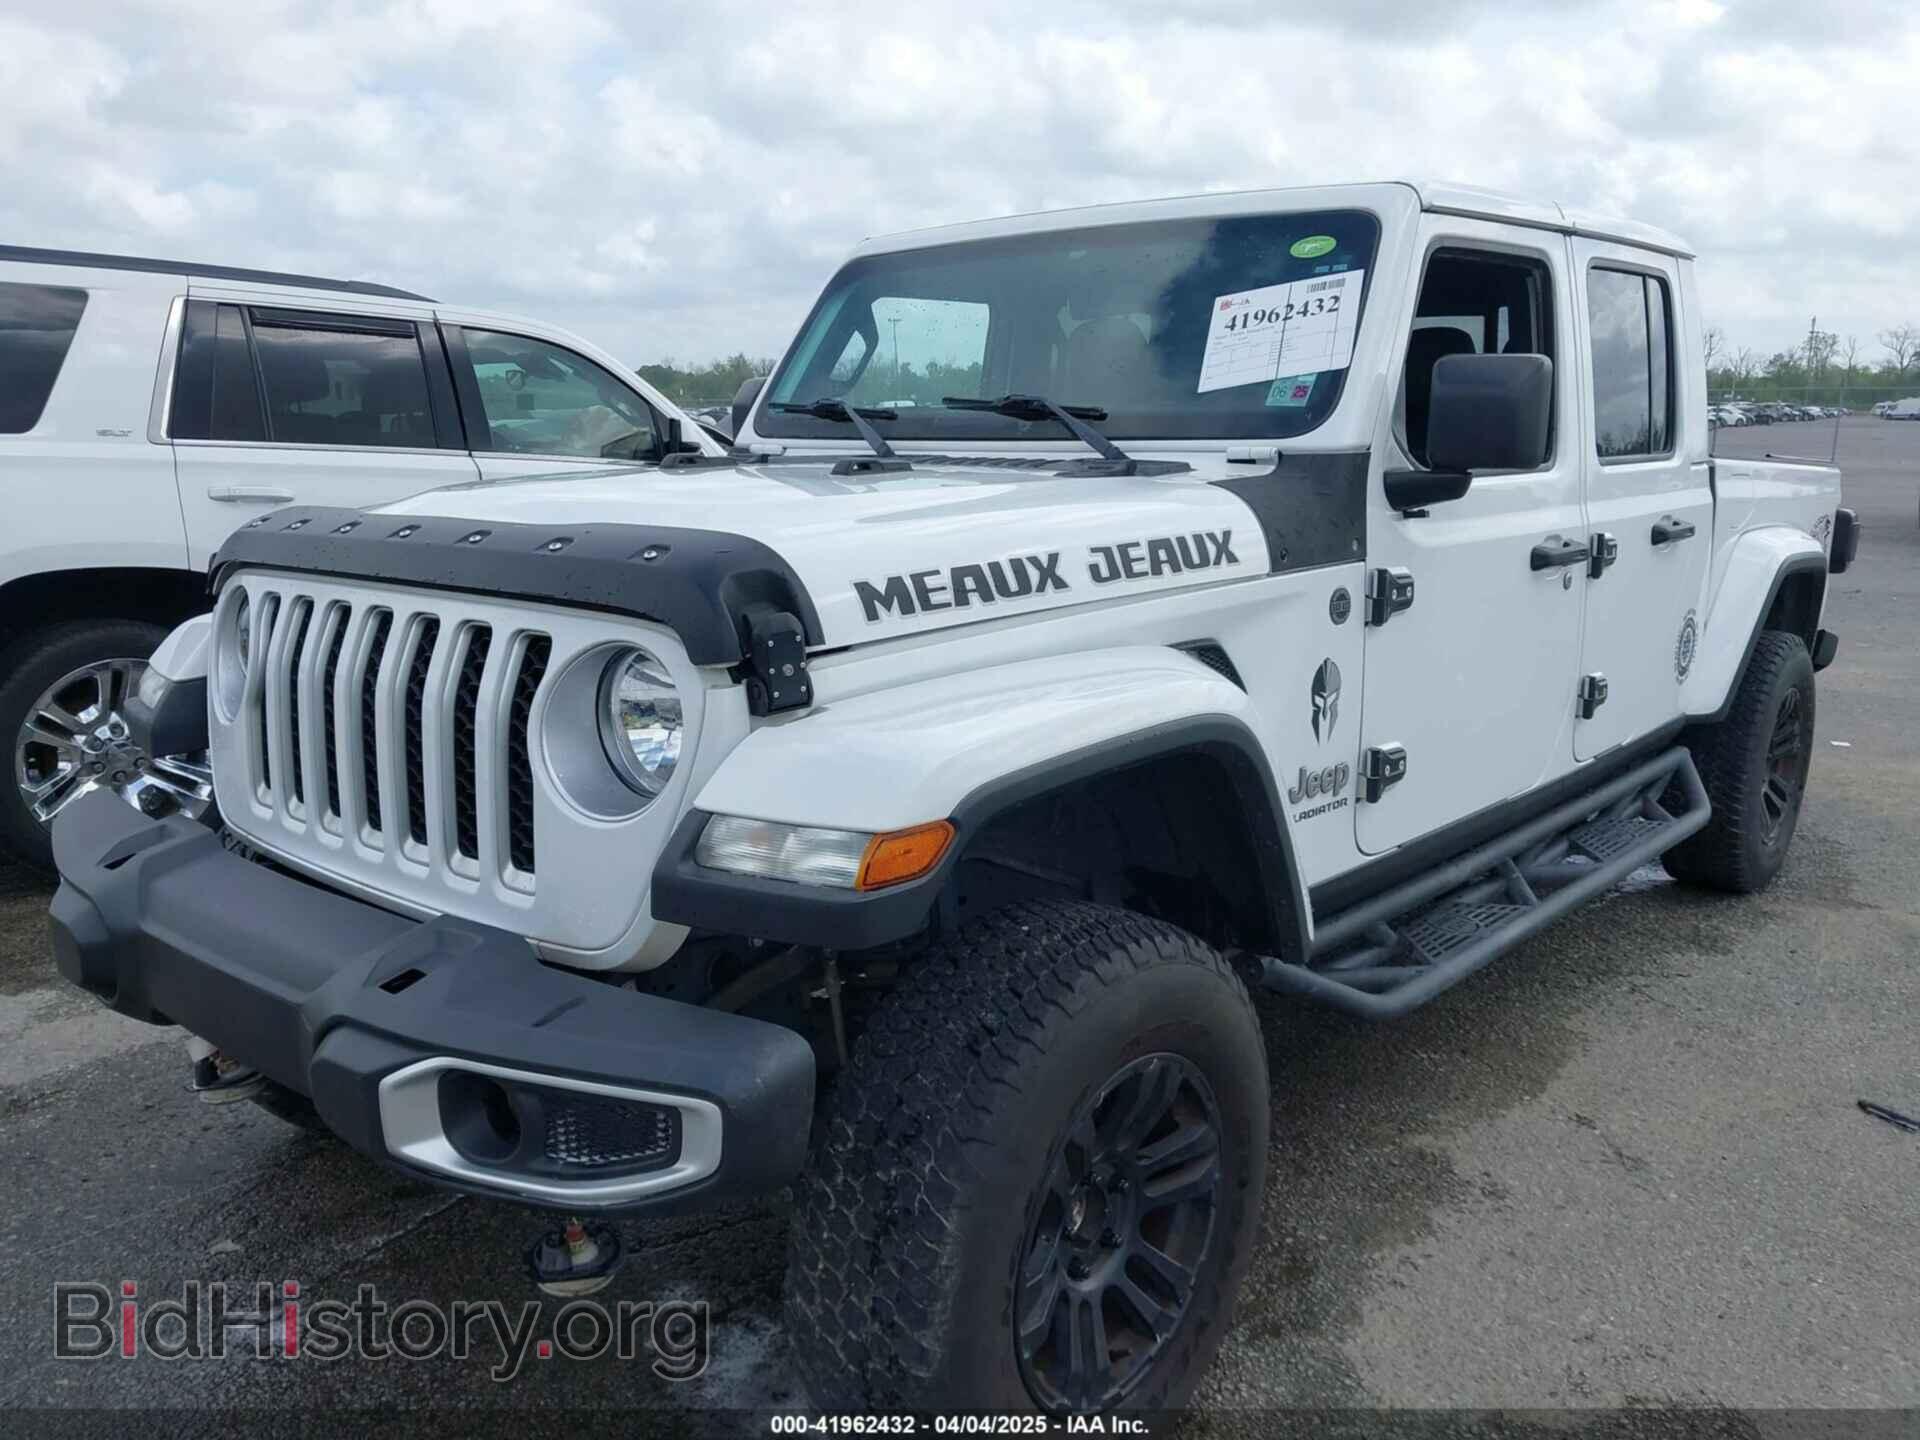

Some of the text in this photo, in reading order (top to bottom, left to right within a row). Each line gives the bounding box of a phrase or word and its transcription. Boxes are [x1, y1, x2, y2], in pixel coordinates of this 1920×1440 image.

[1225, 296, 1340, 331] 41962432
[852, 529, 1241, 622] MEAUX JEAUX
[1288, 762, 1350, 804] Jeep
